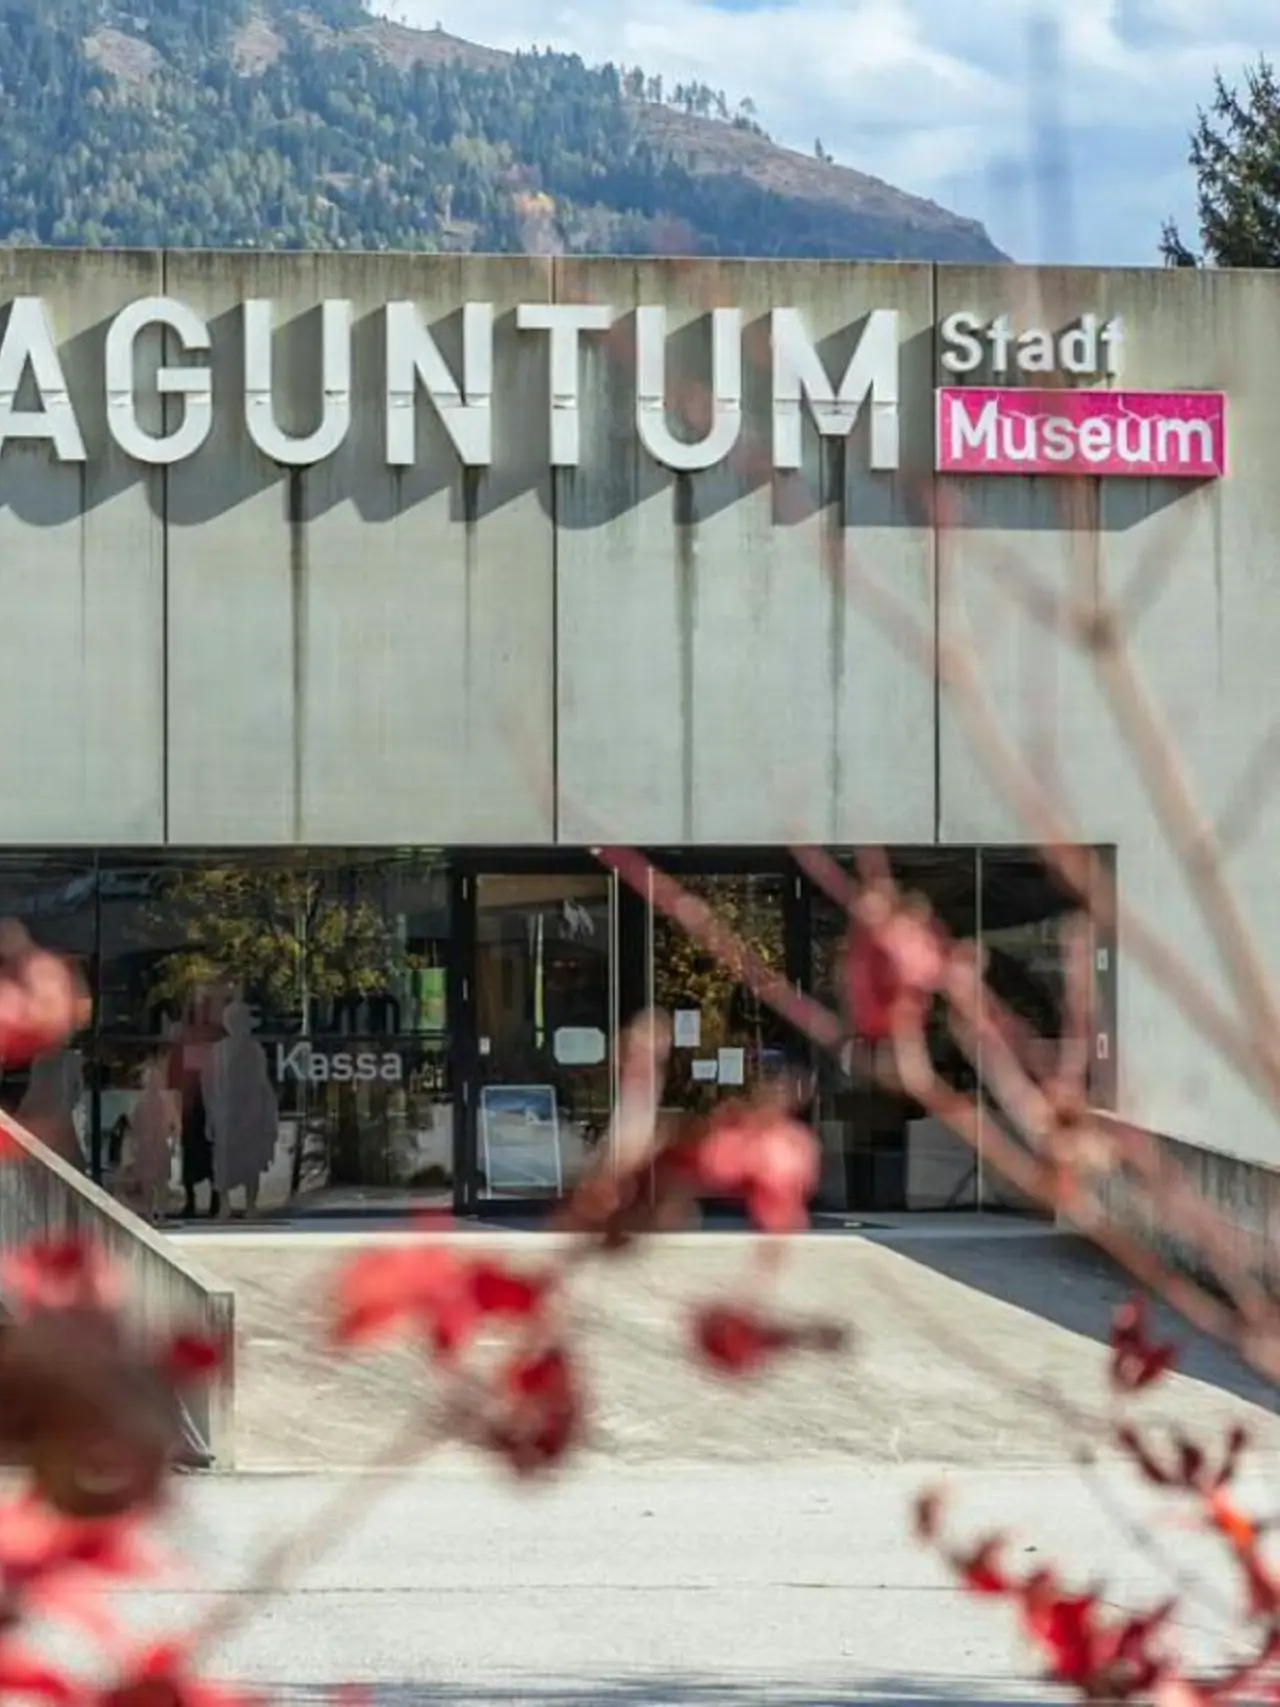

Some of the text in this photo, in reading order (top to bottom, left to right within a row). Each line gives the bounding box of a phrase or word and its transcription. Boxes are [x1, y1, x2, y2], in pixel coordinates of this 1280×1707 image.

[940, 311, 1123, 373] Stadt
[950, 399, 1214, 462] Museum
[276, 1041, 402, 1082] Kassa
